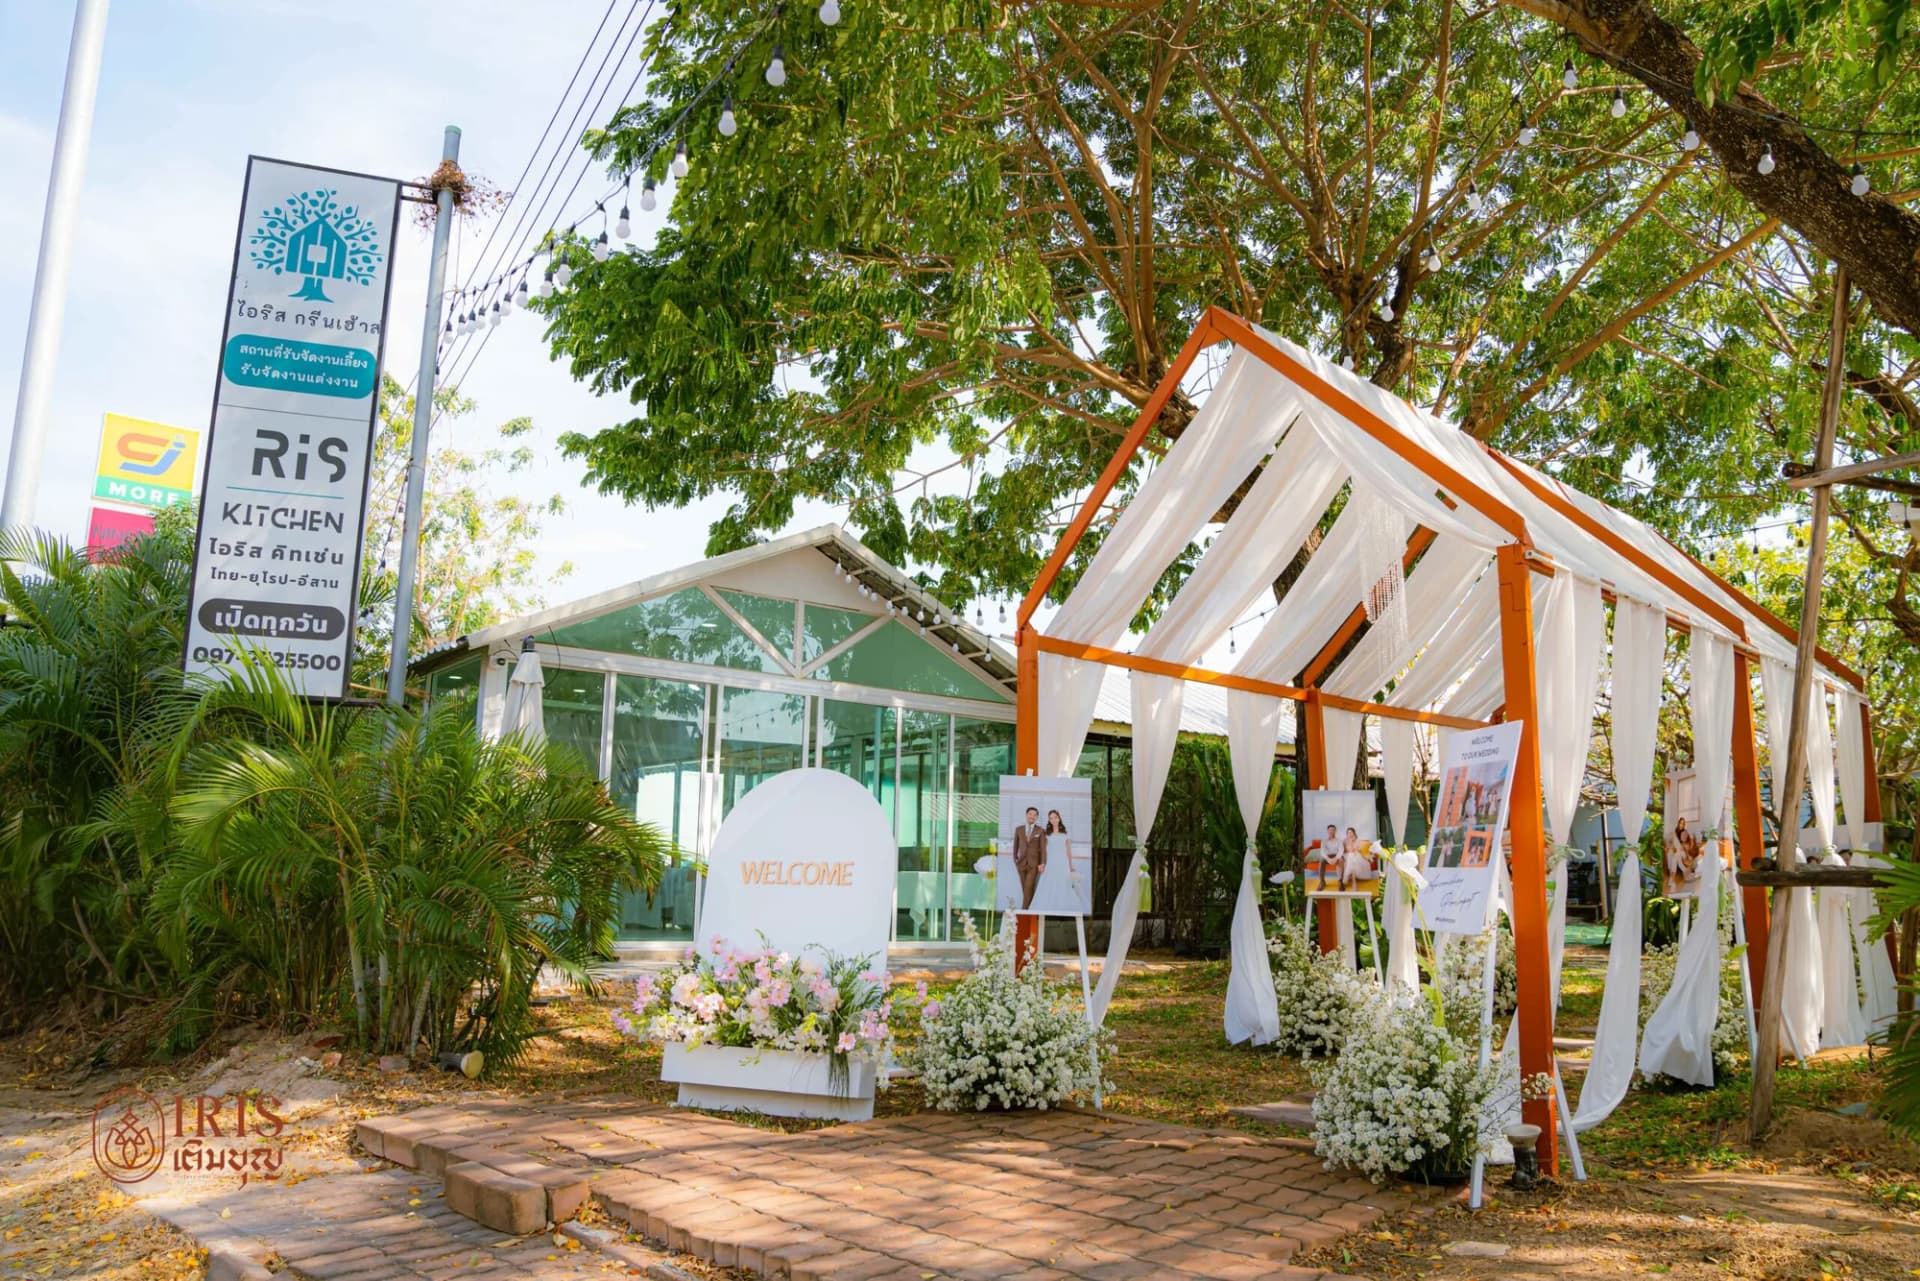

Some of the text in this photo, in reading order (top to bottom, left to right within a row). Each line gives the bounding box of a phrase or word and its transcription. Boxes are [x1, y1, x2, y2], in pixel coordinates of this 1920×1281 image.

[237, 299, 286, 323] ไอริส
[239, 343, 368, 369] สถานที่รับจัดงานเลี้ยง
[240, 362, 359, 388] รับจัดงานแต่งงาน
[222, 502, 344, 534] KITCHEN
[209, 537, 344, 565] ไอริส คิทเช่น
[210, 566, 339, 589] ไทย-ยุโรป-อีสาน
[215, 604, 328, 636] เปิดทุกวัน
[740, 861, 855, 886] WELCOME
